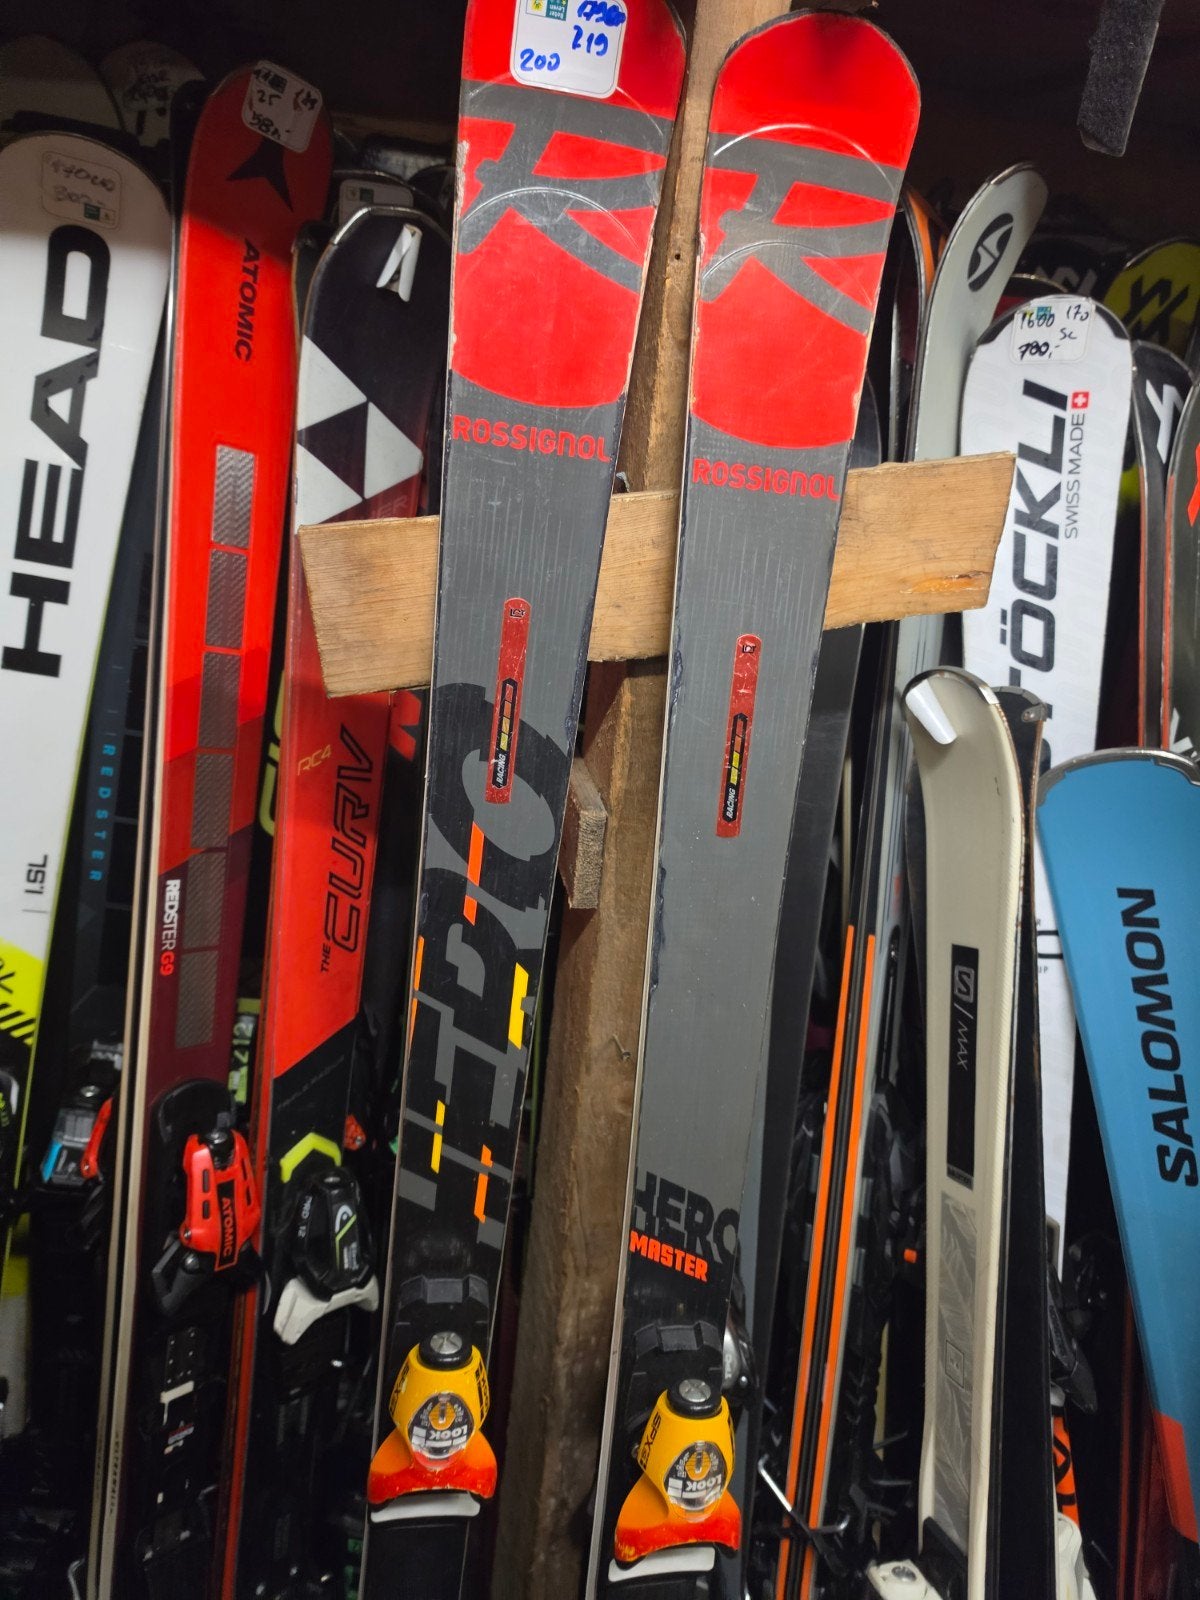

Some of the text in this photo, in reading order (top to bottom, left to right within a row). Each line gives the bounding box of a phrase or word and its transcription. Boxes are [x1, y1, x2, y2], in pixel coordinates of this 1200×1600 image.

[520, 48, 561, 71] 200
[234, 238, 260, 362] ATOMIC
[1, 224, 111, 677] HEAD
[451, 413, 611, 464] ROSSIGNOL
[692, 459, 841, 500] ROSSIGNOL
[1063, 413, 1089, 539] SWISS MADE
[1000, 379, 1069, 772] ÖCKLI
[496, 753, 507, 784] RACING
[88, 744, 116, 881] REDSTER
[726, 787, 736, 819] RACING
[320, 725, 375, 973] THE CURV
[160, 879, 181, 977] REDSTER G9
[1115, 886, 1199, 1188] SALOMON
[220, 1197, 234, 1258] ATOMIC
[629, 1230, 709, 1282] MASTER
[429, 1424, 468, 1441] LOOK
[685, 1474, 722, 1492] LOOK
